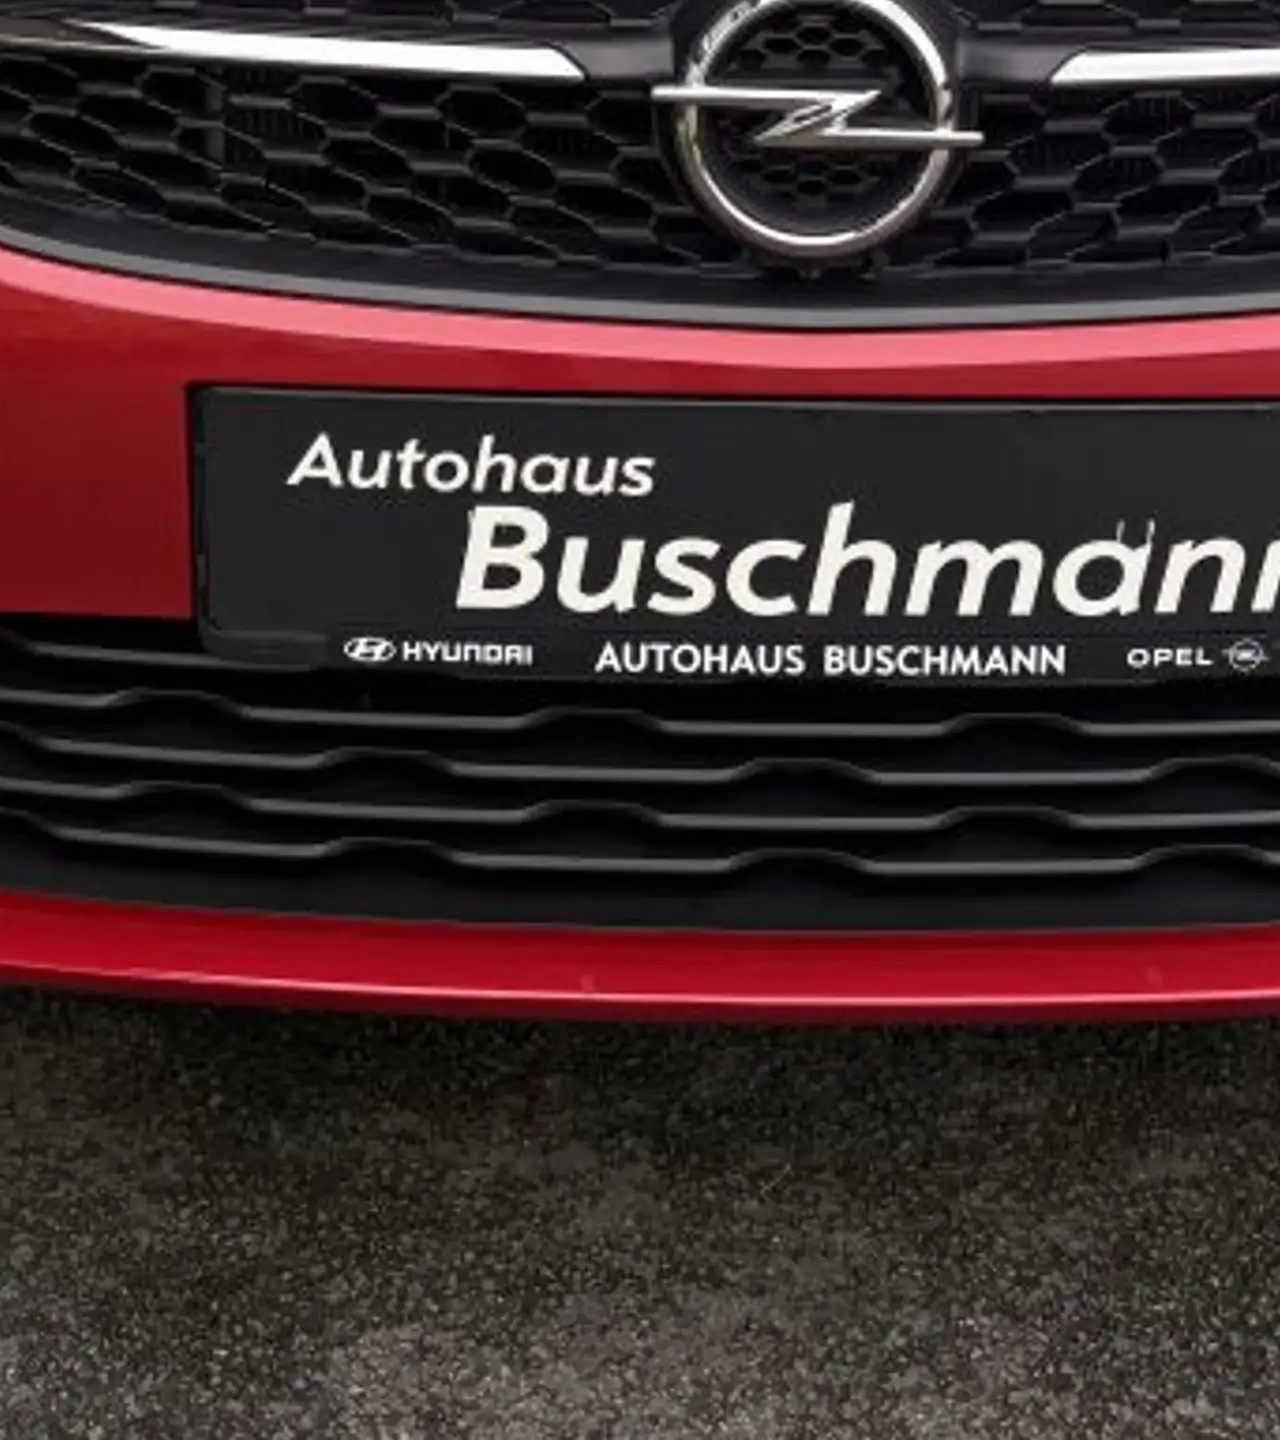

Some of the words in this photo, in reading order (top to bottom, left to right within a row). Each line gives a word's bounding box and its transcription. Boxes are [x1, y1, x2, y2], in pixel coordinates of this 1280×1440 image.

[285, 431, 657, 497] Autohaus
[402, 640, 534, 667] HYUNDAI
[594, 641, 807, 675] AUTOHAUS
[822, 643, 1067, 677] BUSCHMANN
[1125, 646, 1214, 669] OPEL
